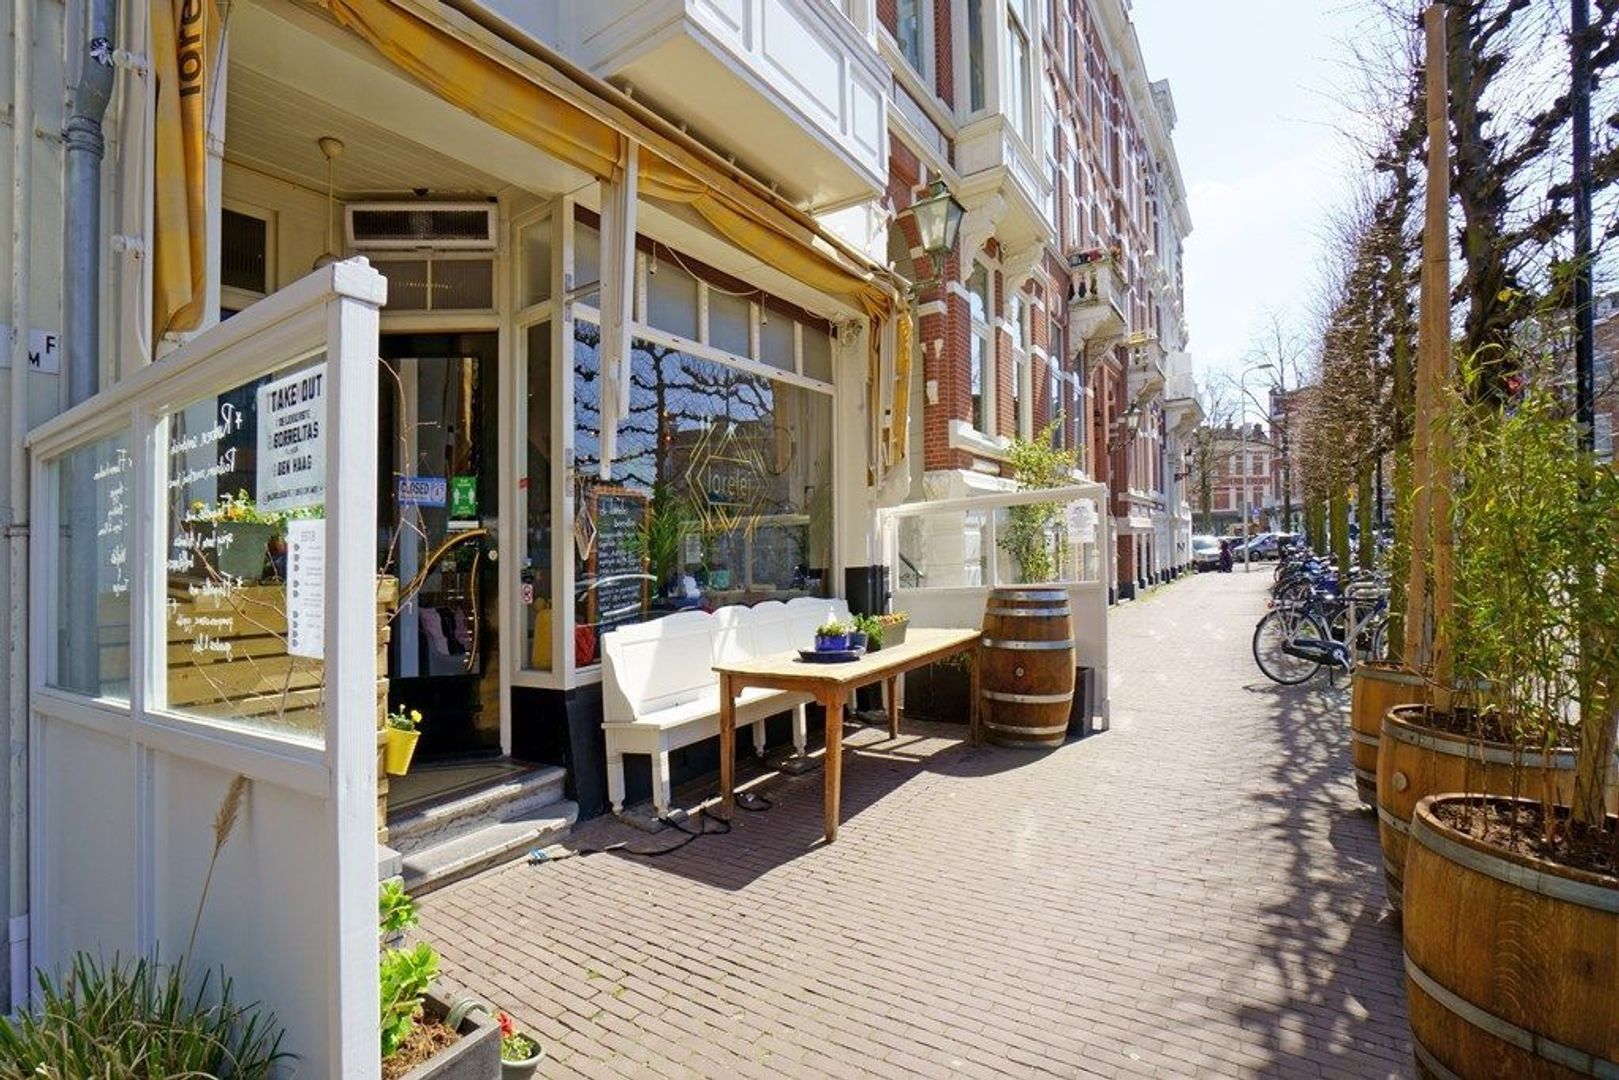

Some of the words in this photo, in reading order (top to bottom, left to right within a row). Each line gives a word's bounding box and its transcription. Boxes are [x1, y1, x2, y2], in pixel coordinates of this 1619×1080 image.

[45, 335, 56, 354] F
[271, 383, 297, 412] TAKE
[301, 374, 322, 402] OUT
[708, 466, 751, 497] lorelei
